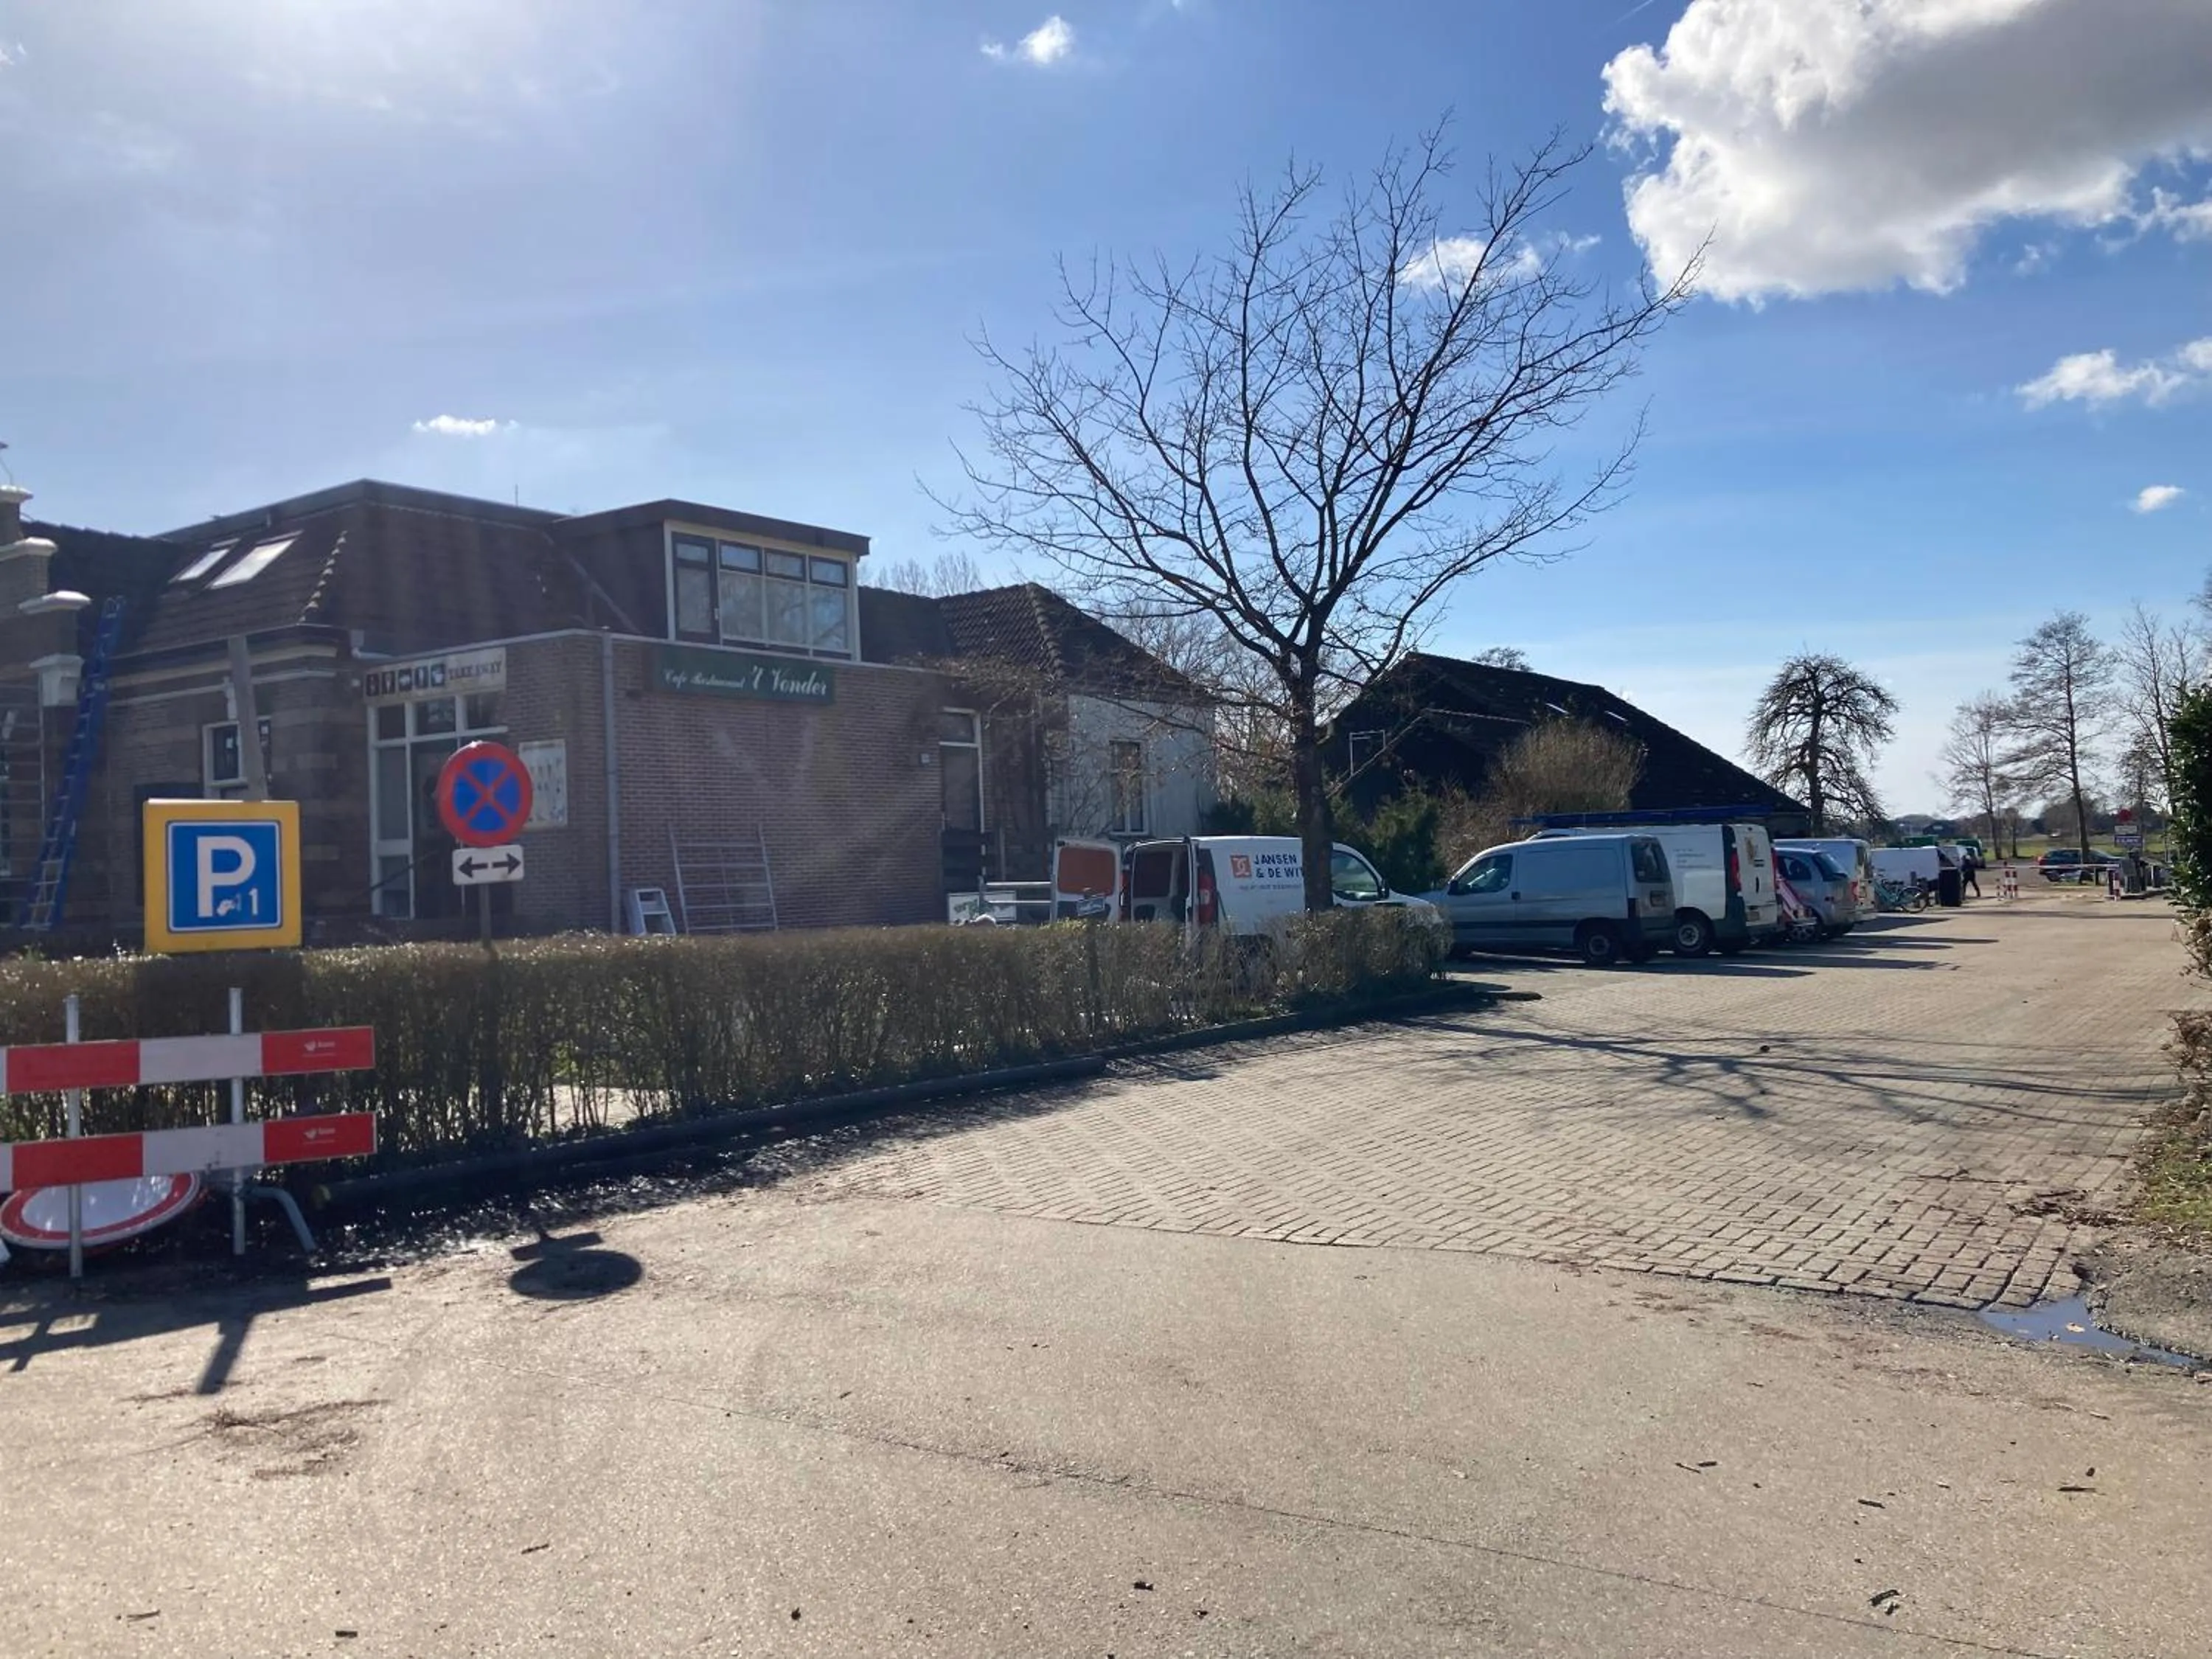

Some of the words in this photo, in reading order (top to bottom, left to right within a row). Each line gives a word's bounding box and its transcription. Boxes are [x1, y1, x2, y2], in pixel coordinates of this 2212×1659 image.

[771, 668, 827, 695] Vonder
[1253, 853, 1298, 865] JANSEN
[197, 835, 256, 917] P
[1256, 867, 1265, 878] &
[1267, 867, 1283, 878] DE
